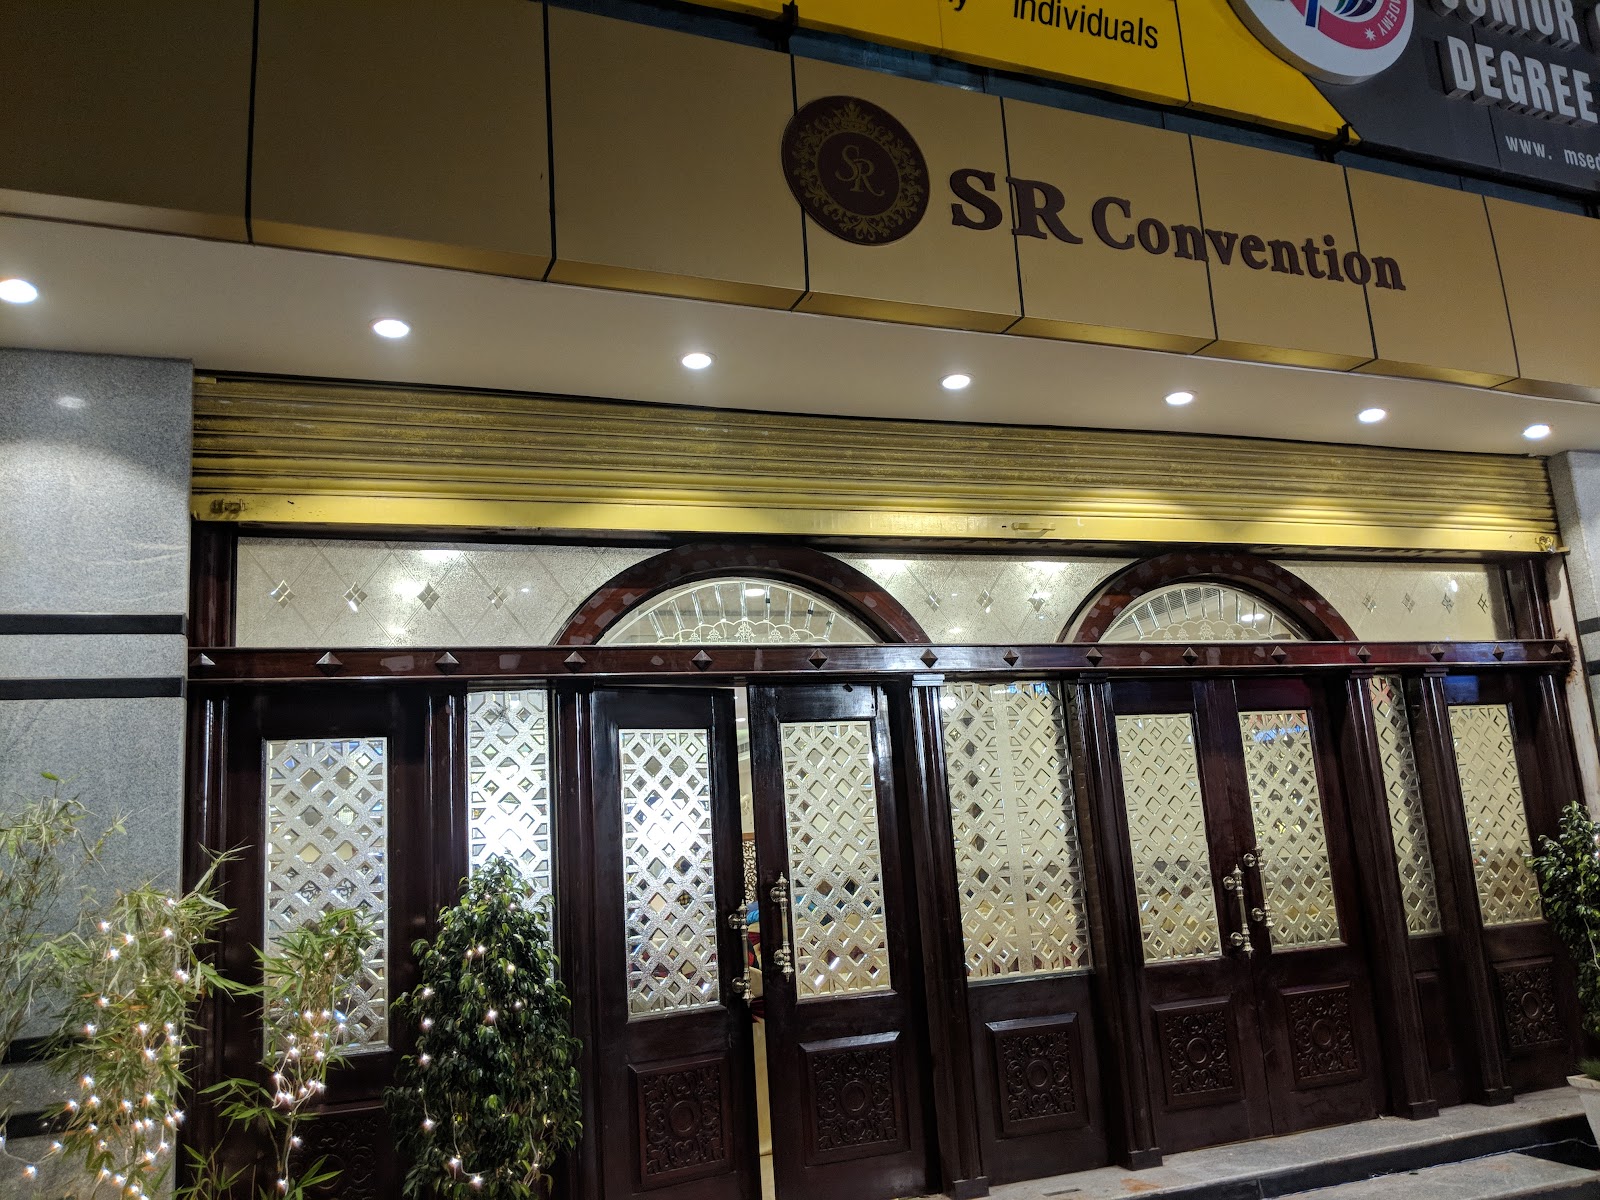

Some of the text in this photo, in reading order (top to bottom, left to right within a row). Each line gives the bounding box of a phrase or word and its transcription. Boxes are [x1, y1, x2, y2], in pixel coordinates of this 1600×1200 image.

[1447, 35, 1598, 124] DEGREE
[835, 145, 885, 197] SR
[1505, 135, 1552, 160] www.
[949, 168, 1407, 291] SR Convention
